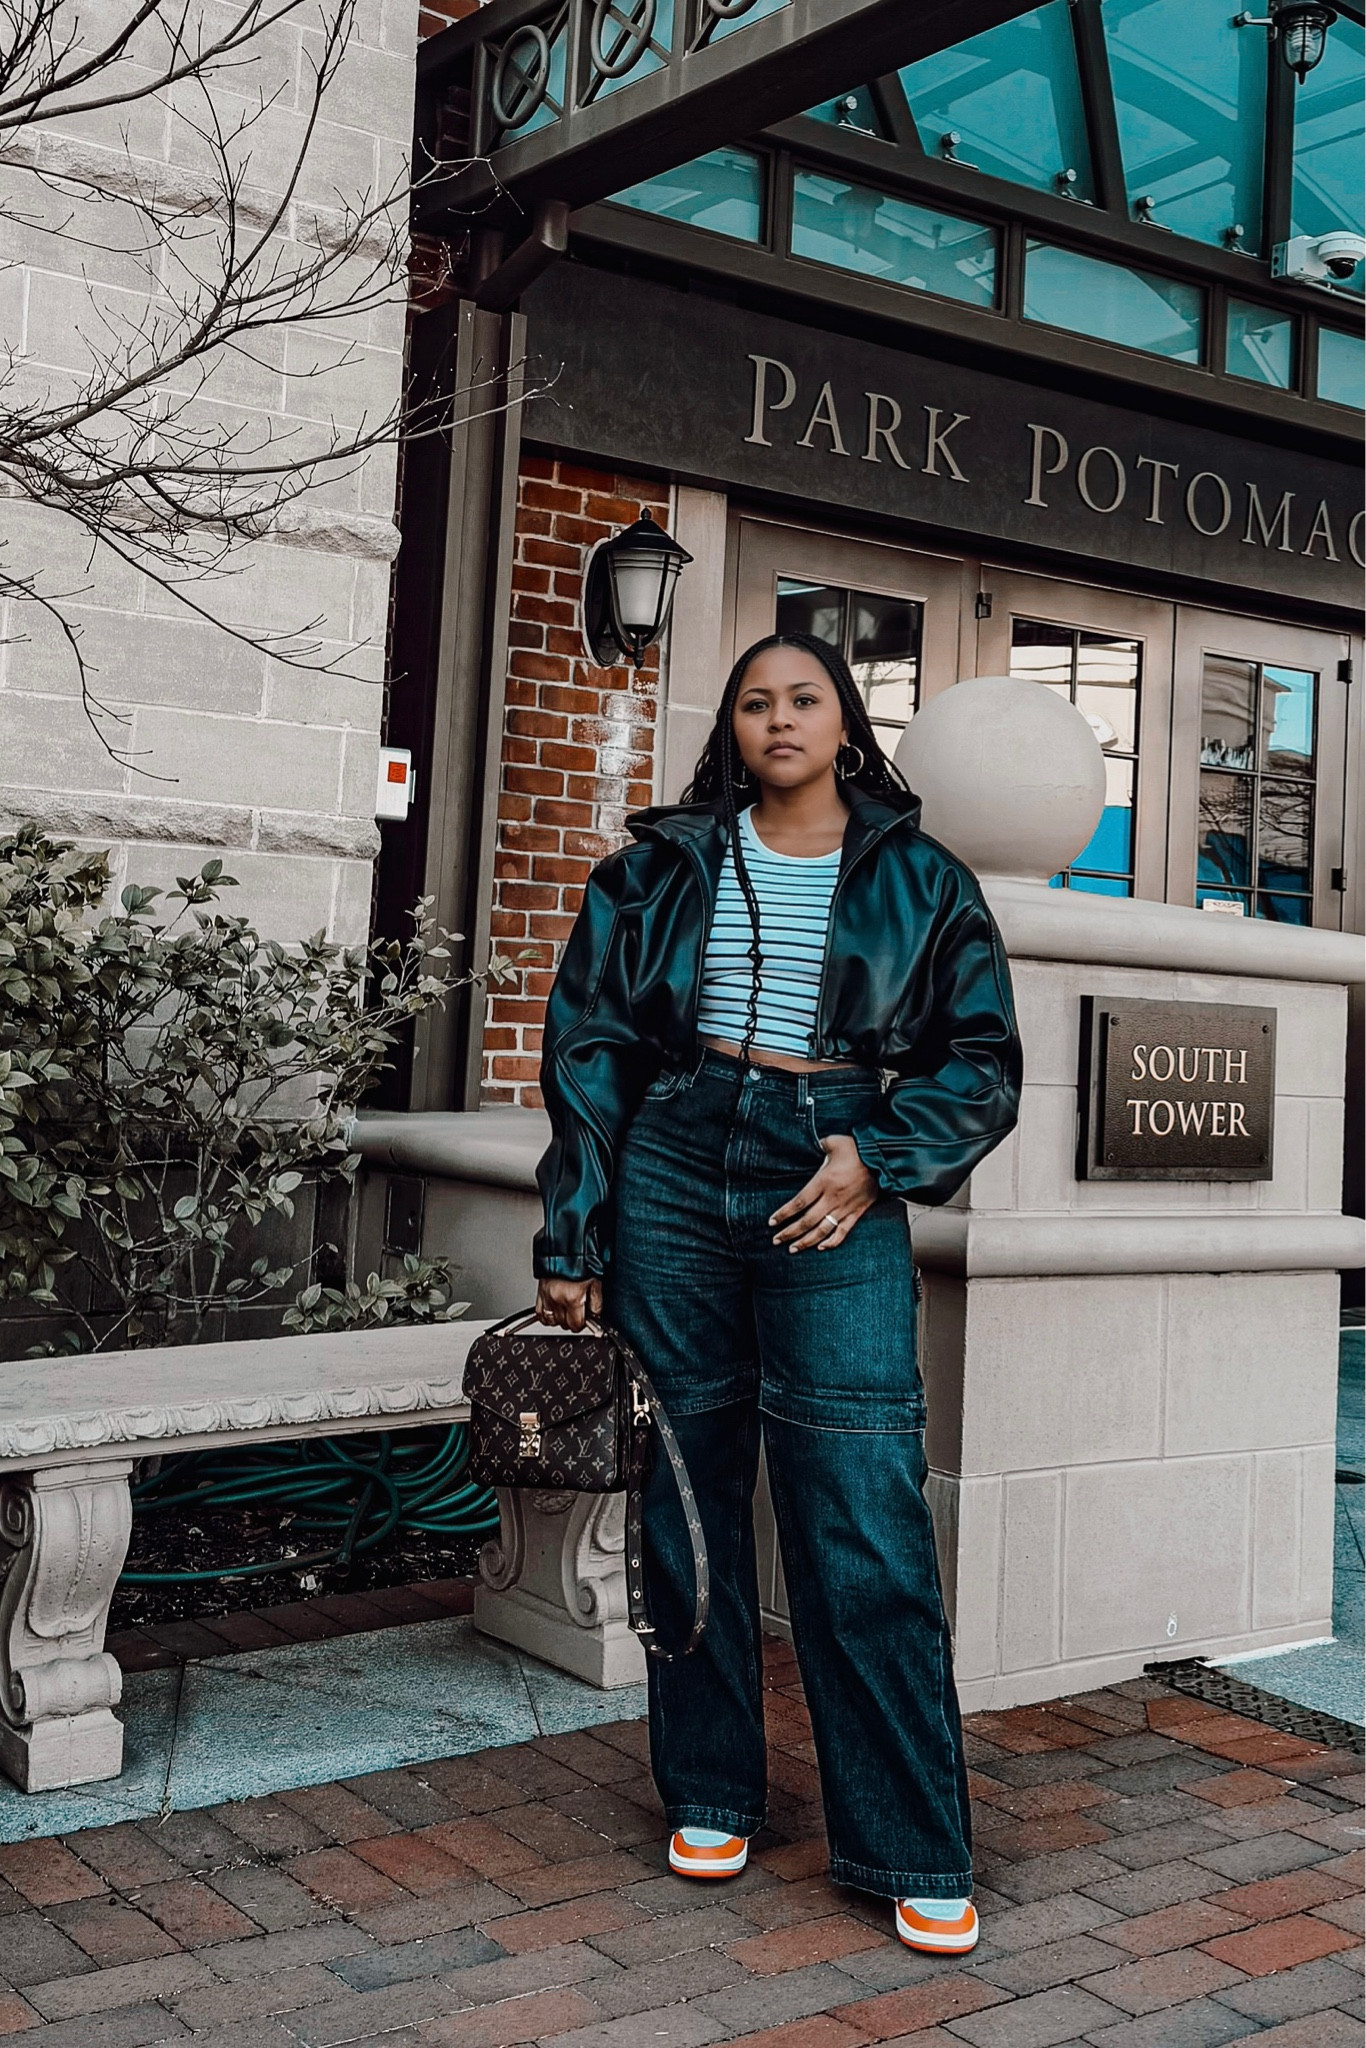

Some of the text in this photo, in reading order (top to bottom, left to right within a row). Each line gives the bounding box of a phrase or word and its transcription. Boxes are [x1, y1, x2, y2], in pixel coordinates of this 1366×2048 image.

[743, 354, 971, 484] PARK
[1131, 1044, 1249, 1084] SOUTH
[1126, 1099, 1251, 1137] TOWER
